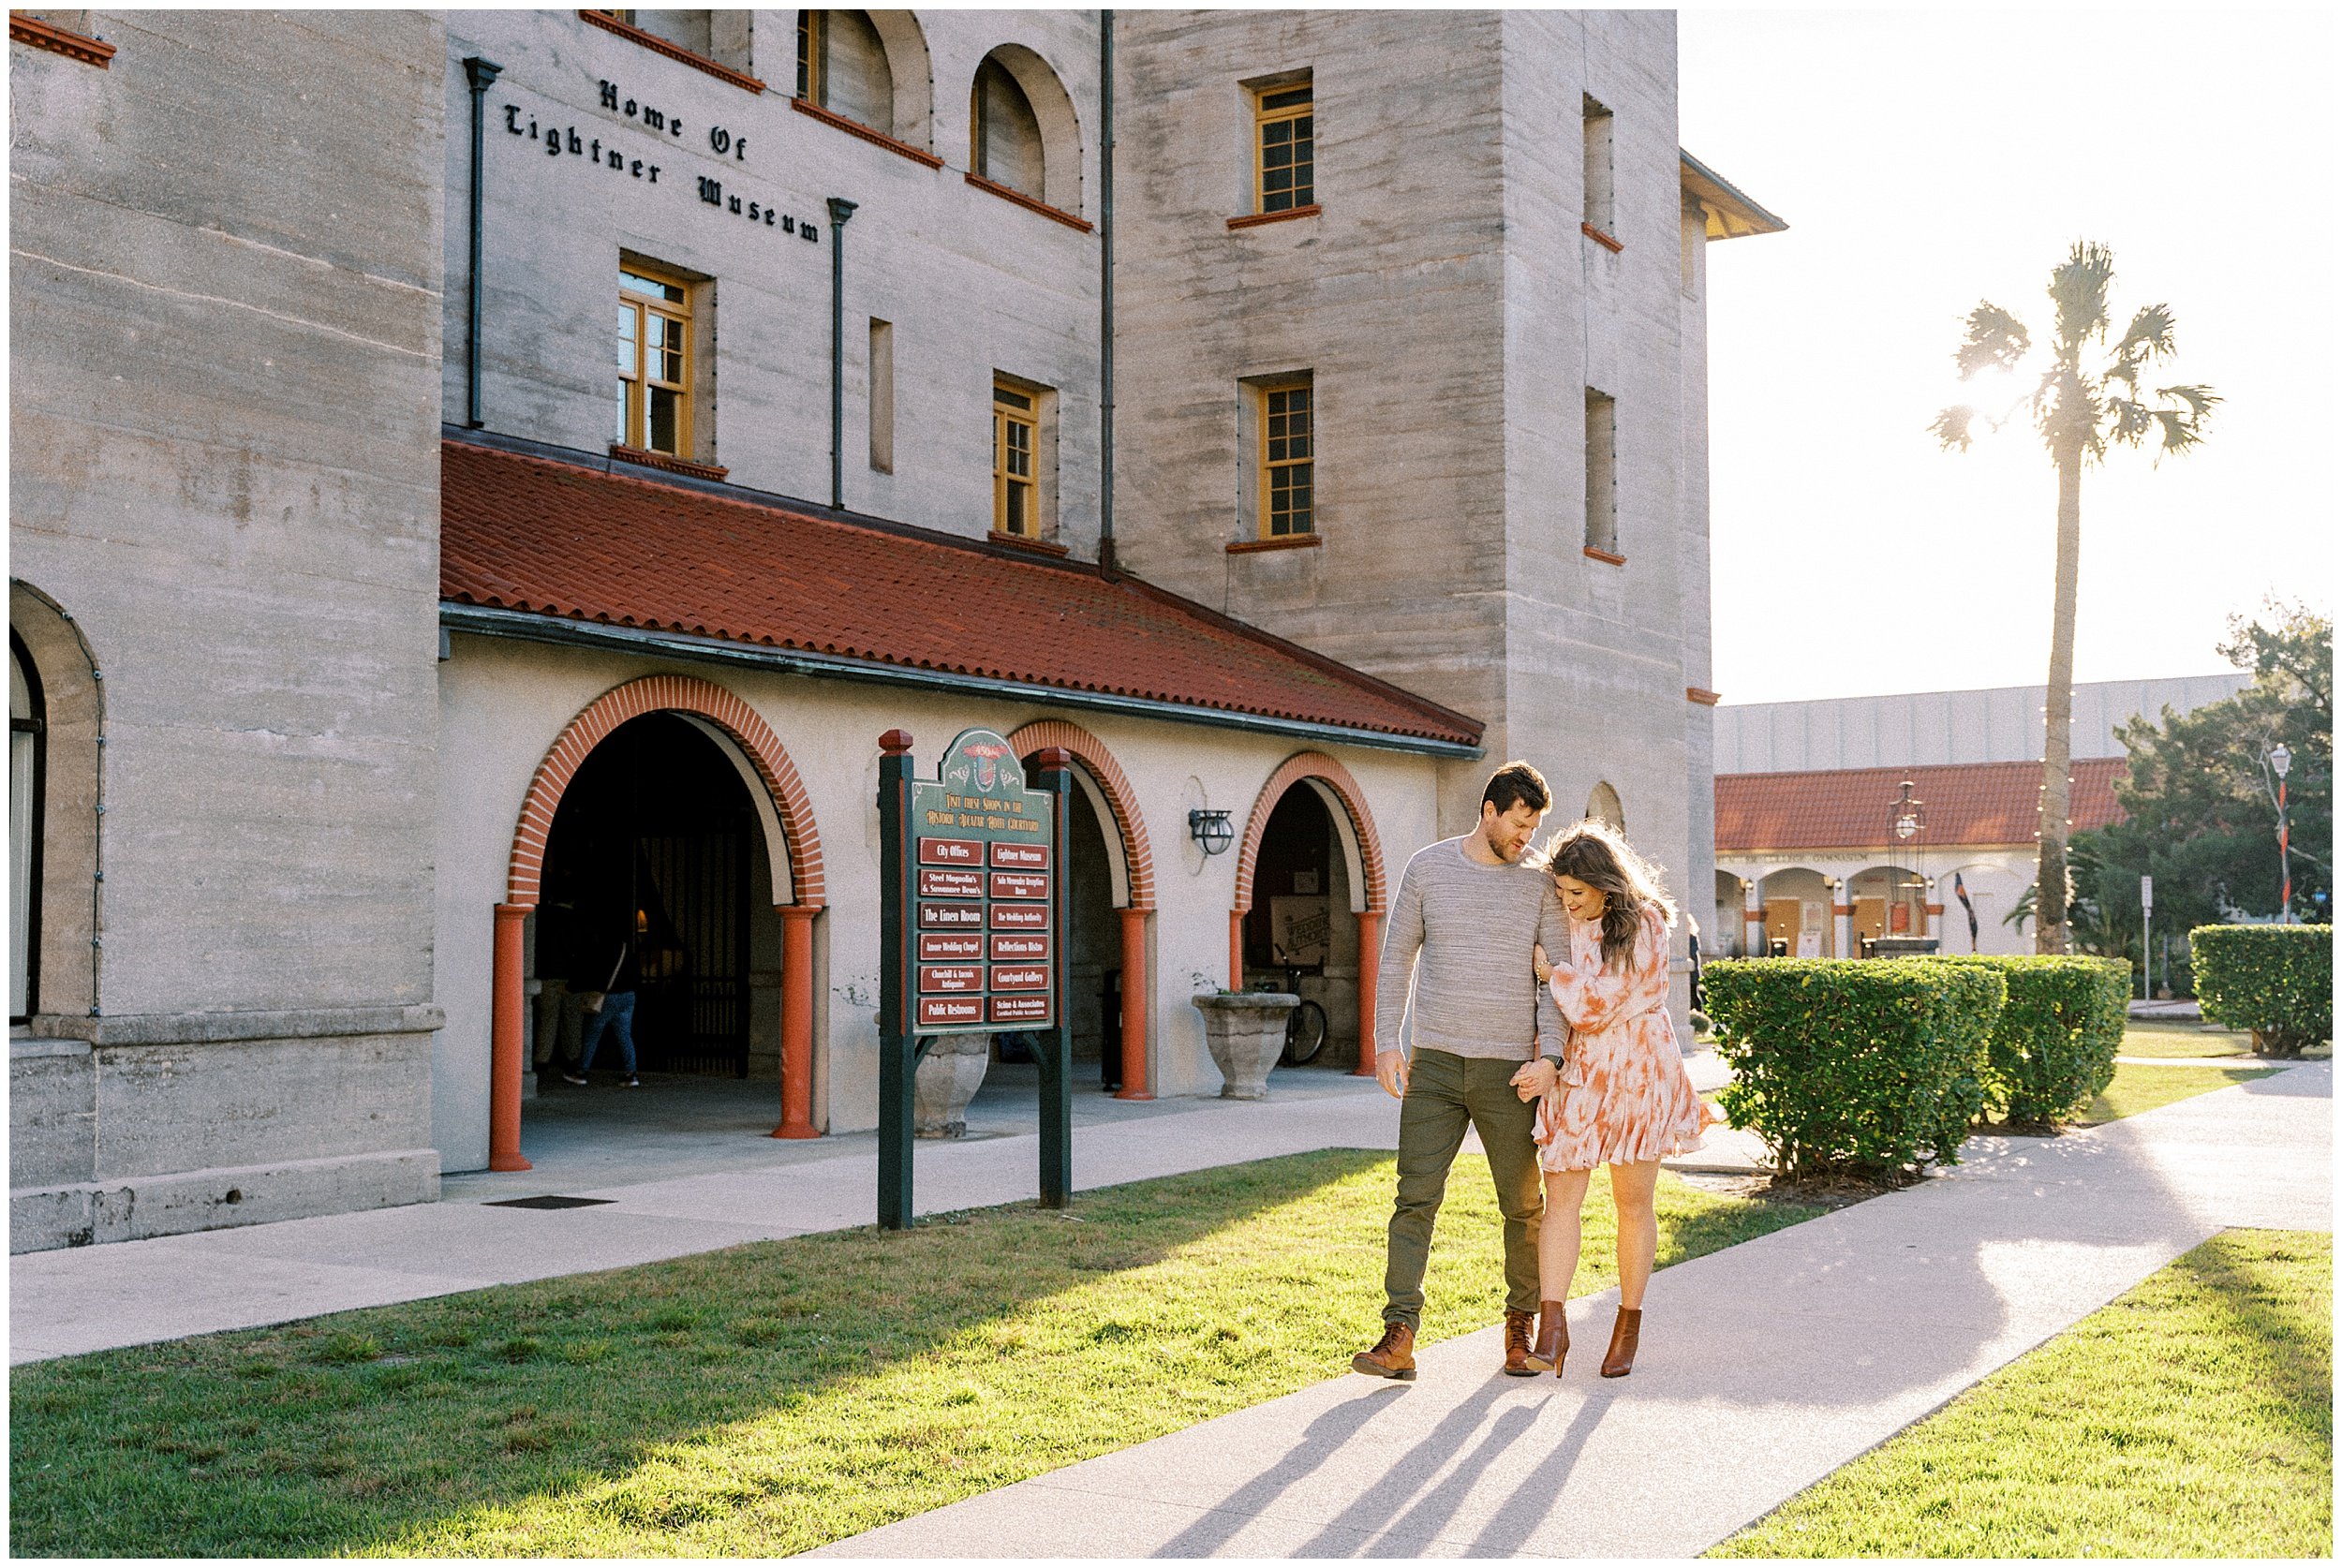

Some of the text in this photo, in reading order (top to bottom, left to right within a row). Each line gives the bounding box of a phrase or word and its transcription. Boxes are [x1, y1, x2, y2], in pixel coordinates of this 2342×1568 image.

[600, 79, 747, 161] Home Of
[504, 104, 819, 243] Lightner Museum
[937, 845, 969, 859] City Offices
[998, 849, 1041, 862] Lightner Museum
[928, 873, 944, 881] Steel
[925, 909, 980, 922] The Linen Room
[942, 941, 962, 953] Wedding
[963, 941, 978, 953] Chapel
[998, 940, 1027, 952] Reflections
[998, 970, 1043, 984] Courtyard Gallery
[928, 1003, 976, 1015] Public Restrooms
